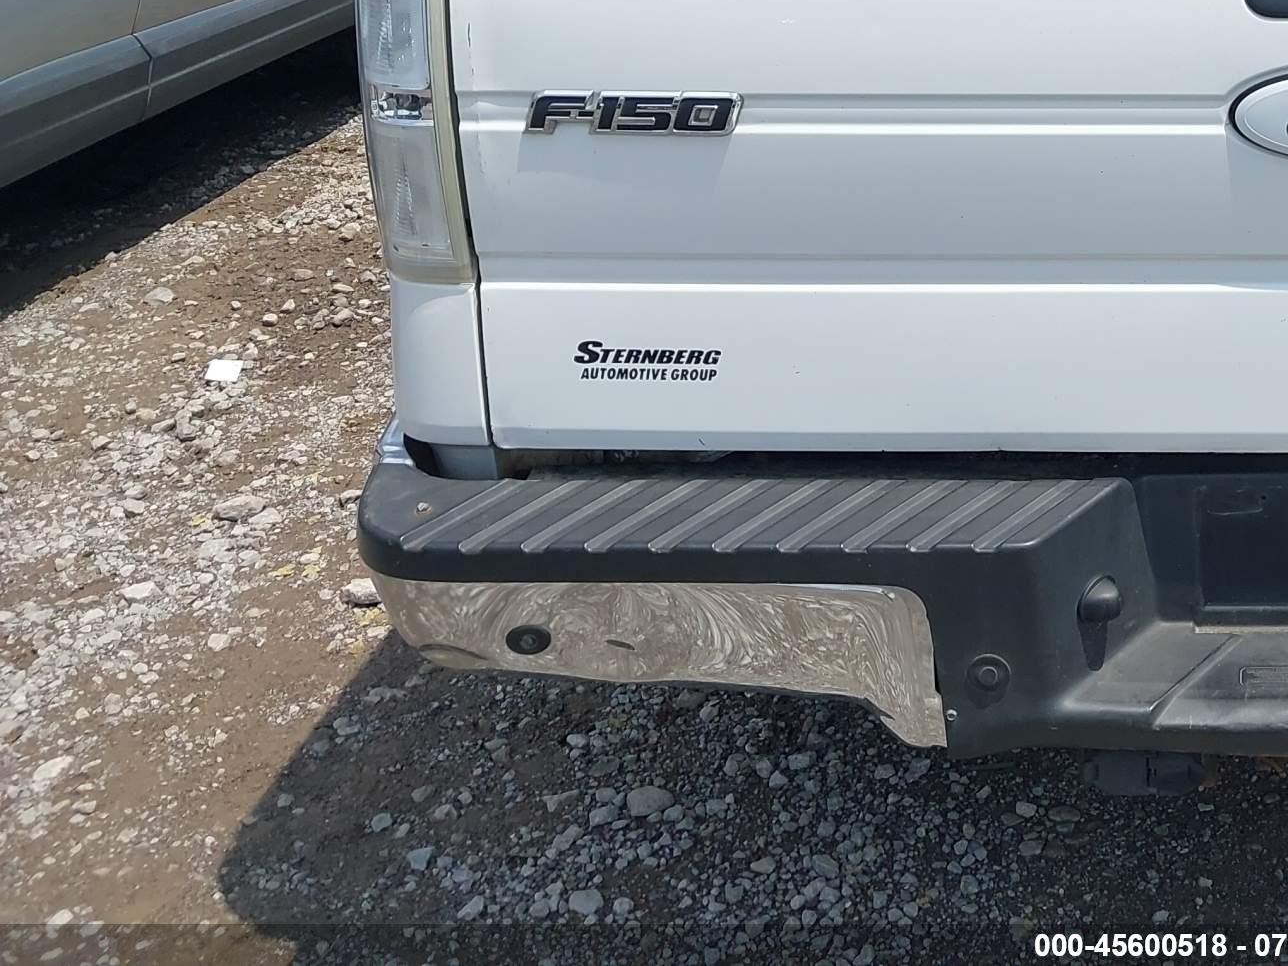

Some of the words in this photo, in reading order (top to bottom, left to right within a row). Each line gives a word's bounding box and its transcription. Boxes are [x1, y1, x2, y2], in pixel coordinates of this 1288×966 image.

[524, 90, 743, 136] F-150
[574, 340, 722, 365] STERNBERG
[581, 367, 668, 381] AUTOMOTIVE
[671, 368, 717, 382] GROUP
